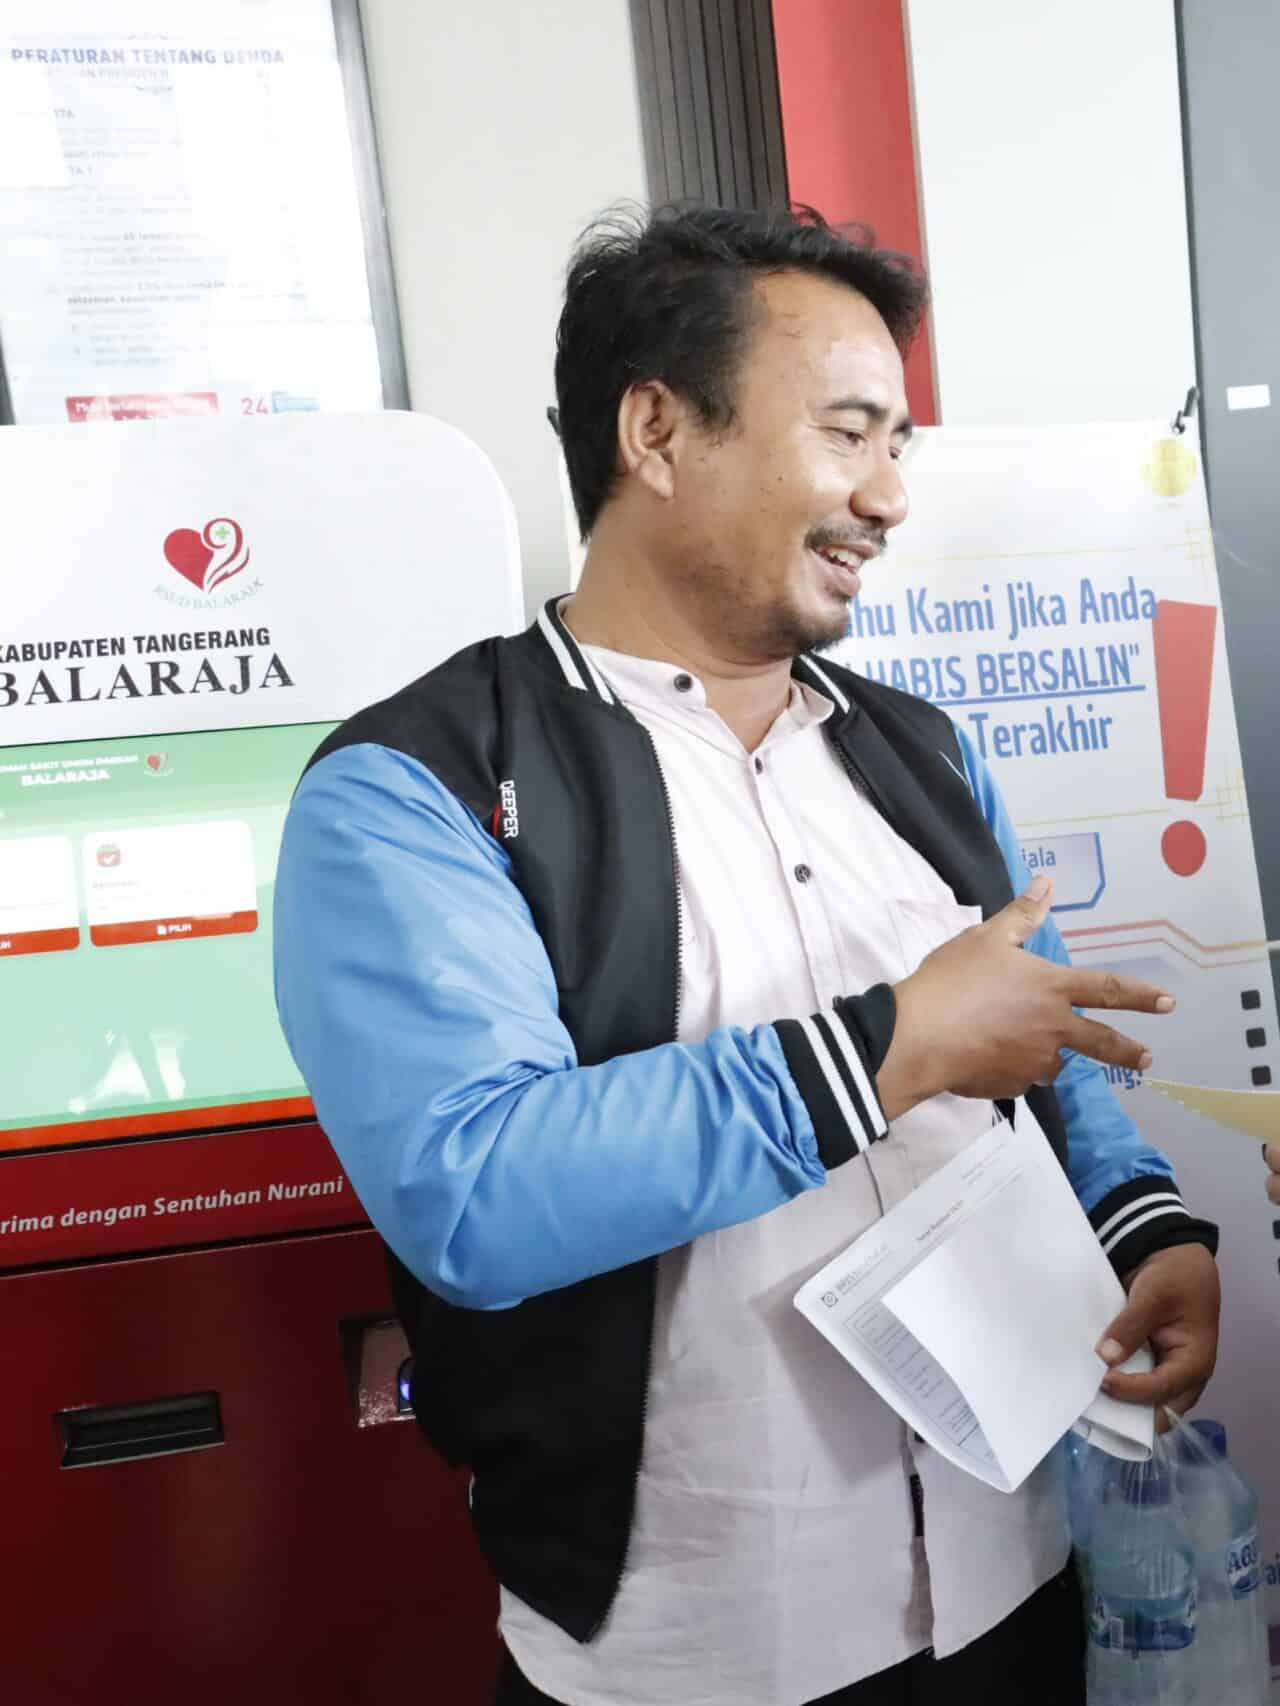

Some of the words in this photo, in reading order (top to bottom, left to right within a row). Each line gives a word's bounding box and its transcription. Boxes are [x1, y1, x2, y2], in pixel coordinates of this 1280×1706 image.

[10, 48, 125, 64] PERATURAN
[131, 48, 217, 64] TENTANG
[241, 397, 268, 416] 24
[905, 582, 995, 635] Kami
[1006, 579, 1068, 641] Jika
[1079, 574, 1158, 625] Anda
[132, 626, 272, 655] TANGERANG
[0, 651, 296, 708] BALARAJA
[976, 642, 1141, 697] BERSALIN"
[967, 702, 1113, 761] Terakhir
[21, 768, 110, 787] BALARAJA
[0, 1215, 54, 1235] rima
[60, 1203, 147, 1227] dengan
[152, 1188, 262, 1216] Sentuhan
[267, 1175, 345, 1202] Nurani
